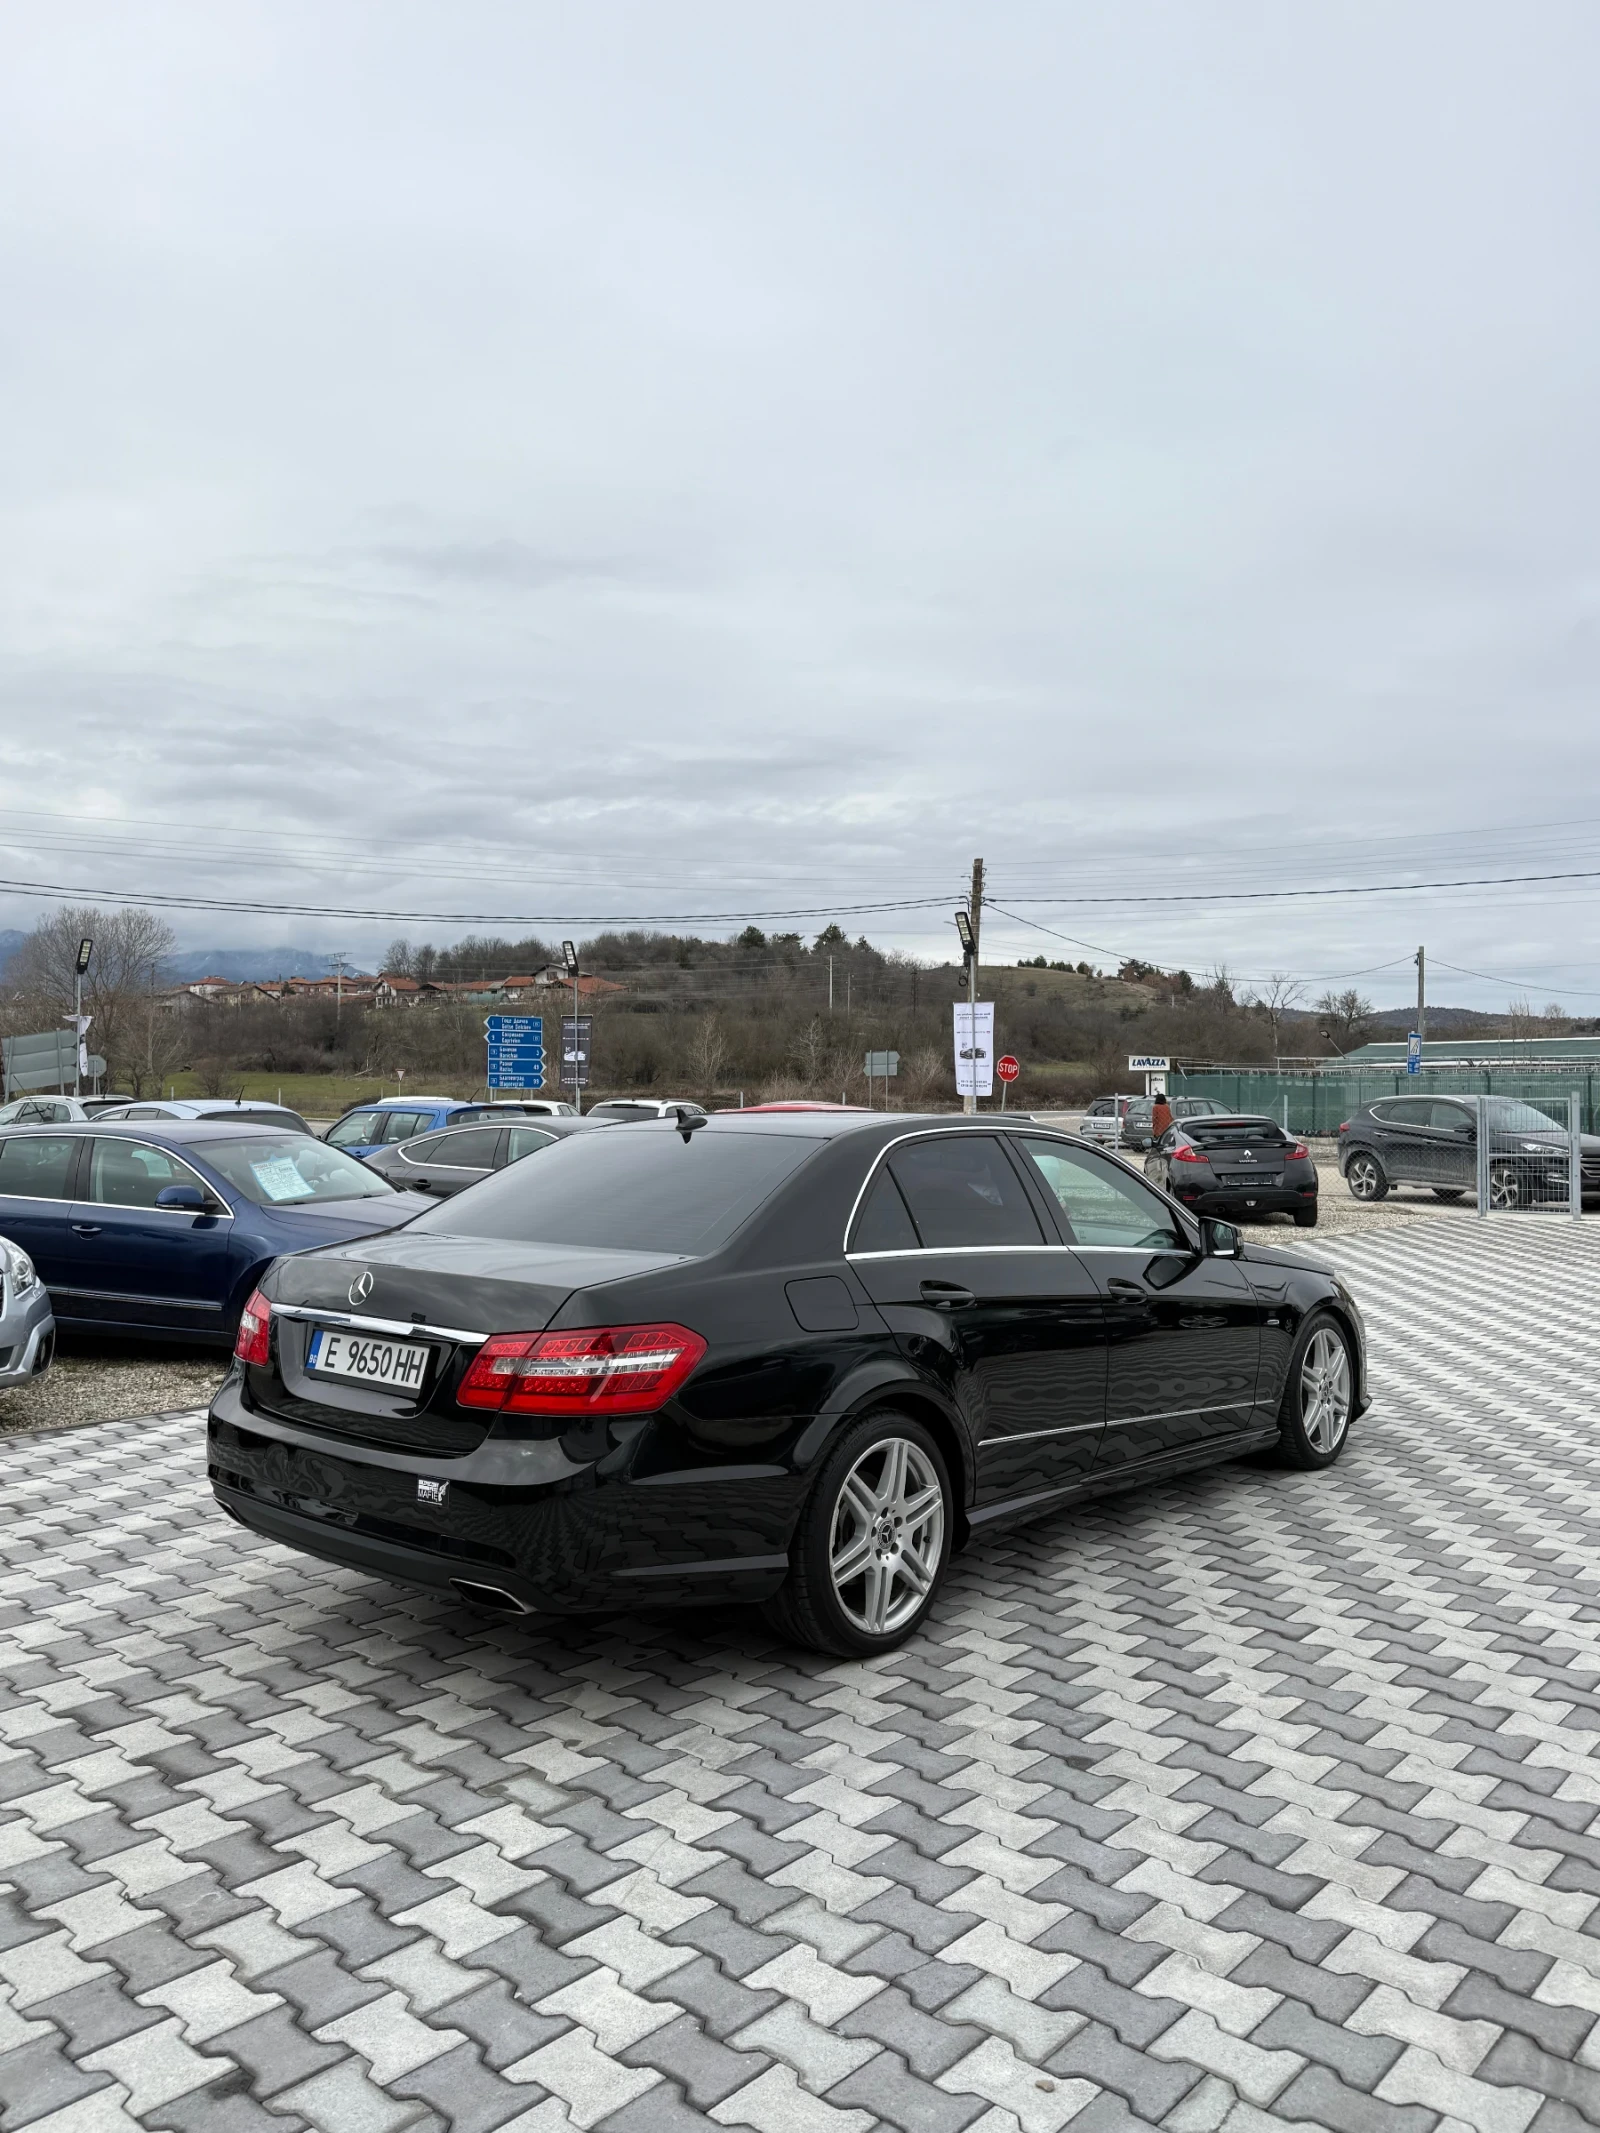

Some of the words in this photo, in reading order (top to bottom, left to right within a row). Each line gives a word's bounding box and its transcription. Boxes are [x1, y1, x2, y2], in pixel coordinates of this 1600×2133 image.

[1132, 1057, 1166, 1067] LAVAZZA
[999, 1062, 1018, 1074] STOP
[308, 1353, 318, 1363] BG
[324, 1337, 341, 1368] E
